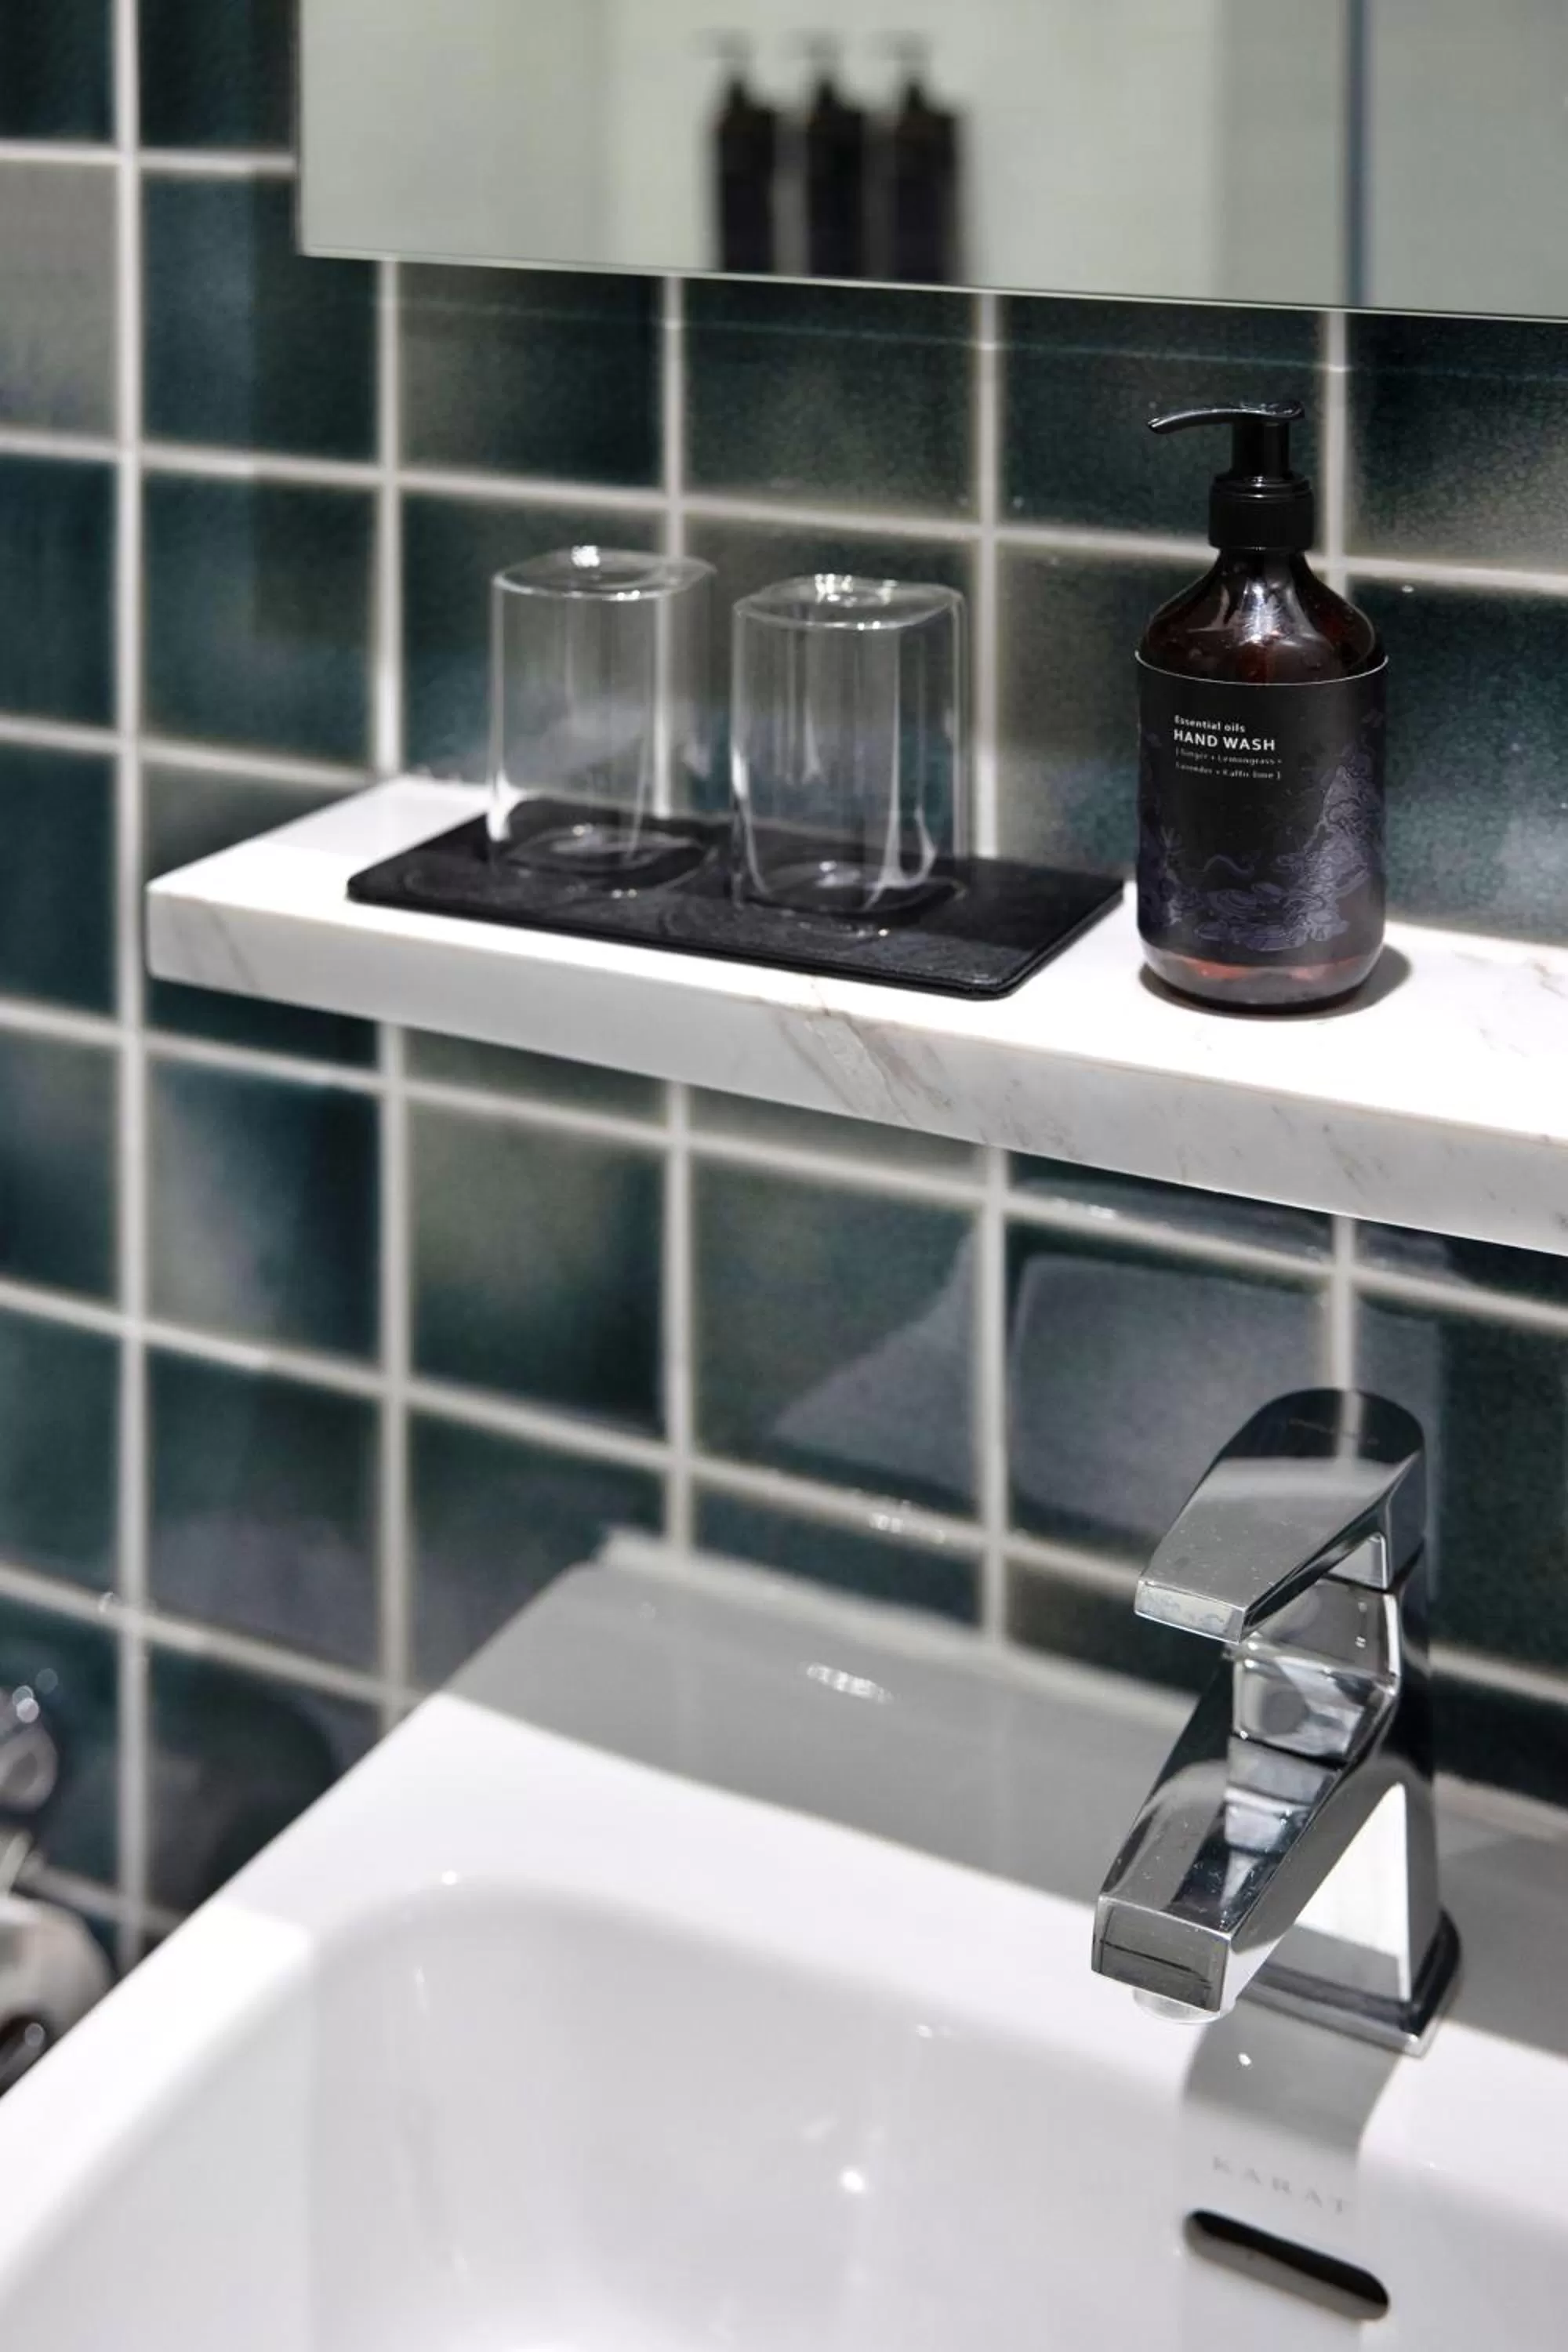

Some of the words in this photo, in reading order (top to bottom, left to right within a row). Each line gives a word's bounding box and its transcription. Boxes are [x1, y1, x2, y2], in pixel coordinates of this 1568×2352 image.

[1174, 714, 1221, 731] Essential
[1224, 722, 1246, 733] oils
[1173, 728, 1218, 747] HAND
[1222, 736, 1276, 751] WASH
